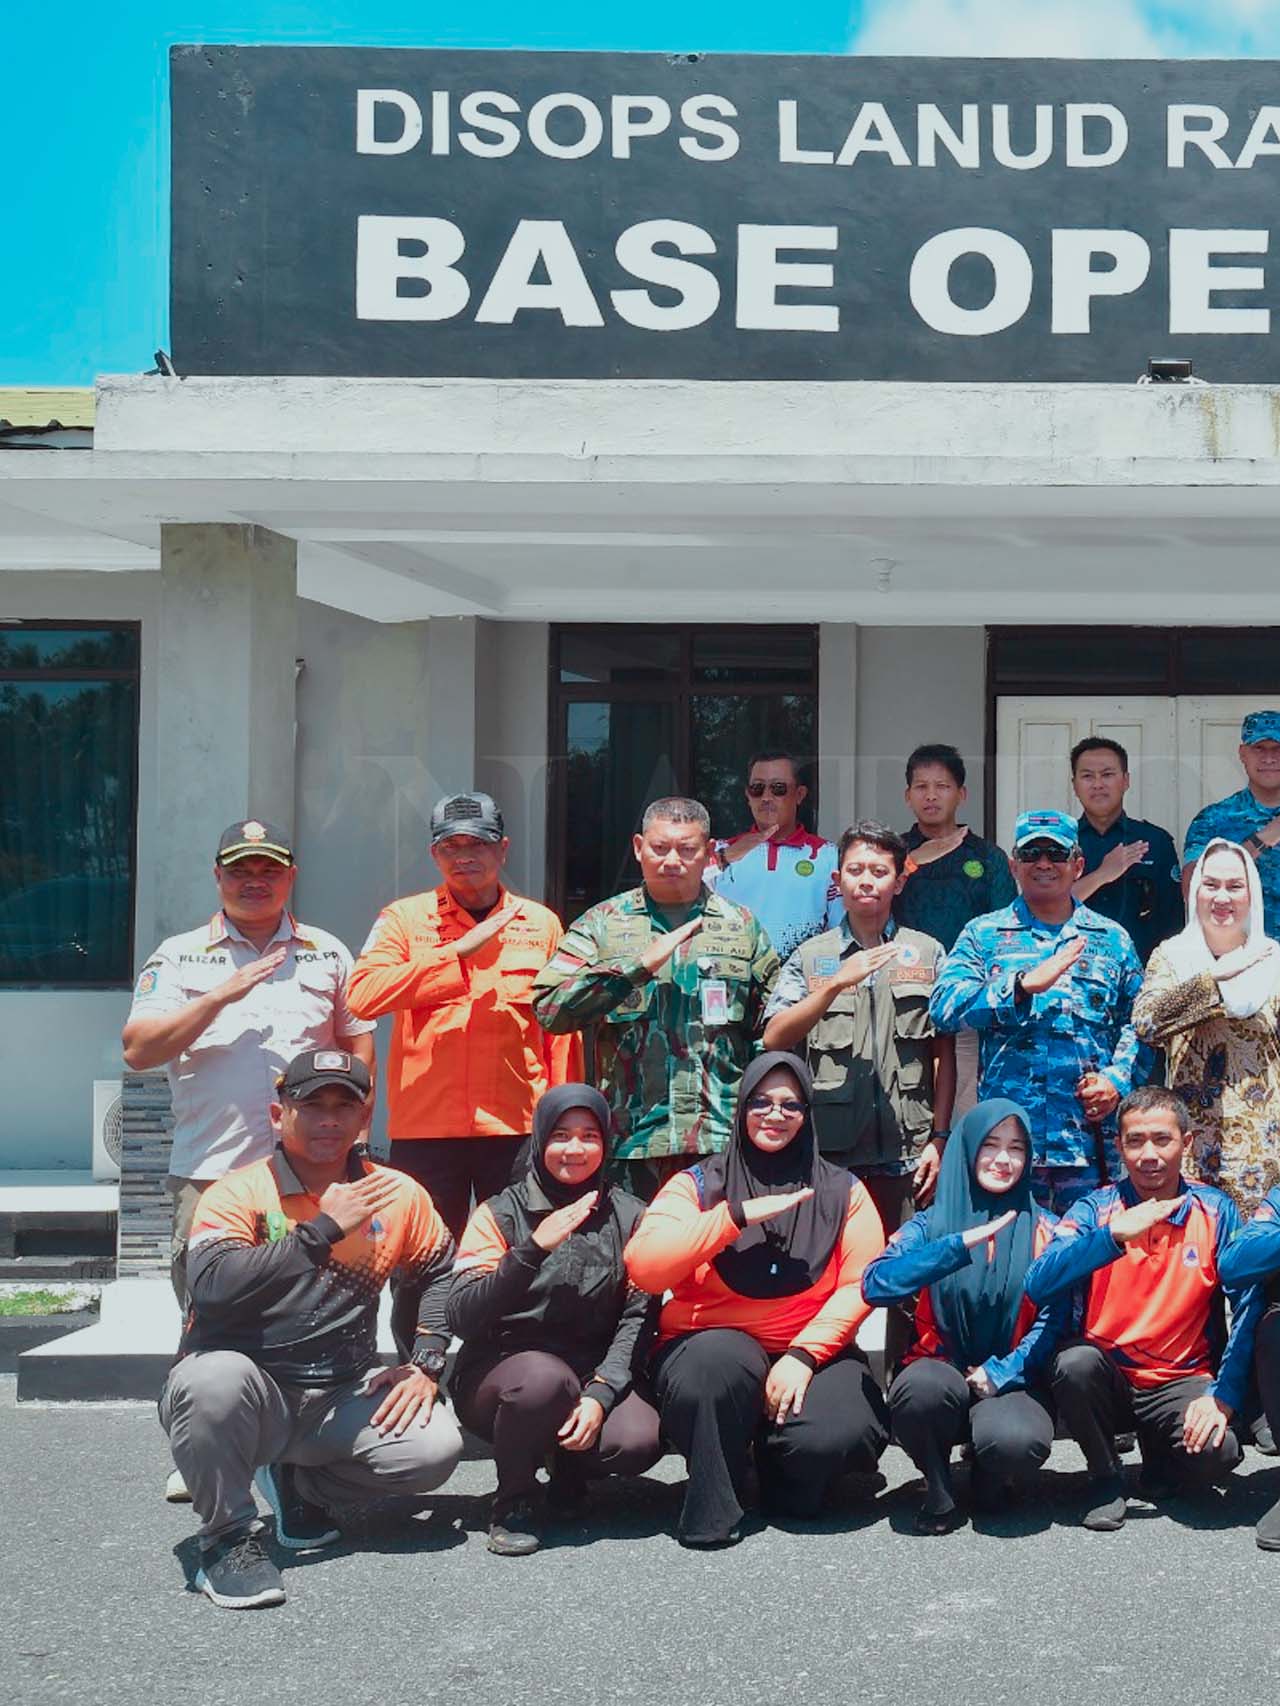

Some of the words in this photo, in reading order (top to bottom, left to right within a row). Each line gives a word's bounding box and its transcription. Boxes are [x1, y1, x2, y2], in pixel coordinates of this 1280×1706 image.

[357, 90, 740, 160] DISOPS
[779, 100, 1128, 169] LANUD
[356, 216, 840, 331] BASE
[294, 952, 322, 964] POL
